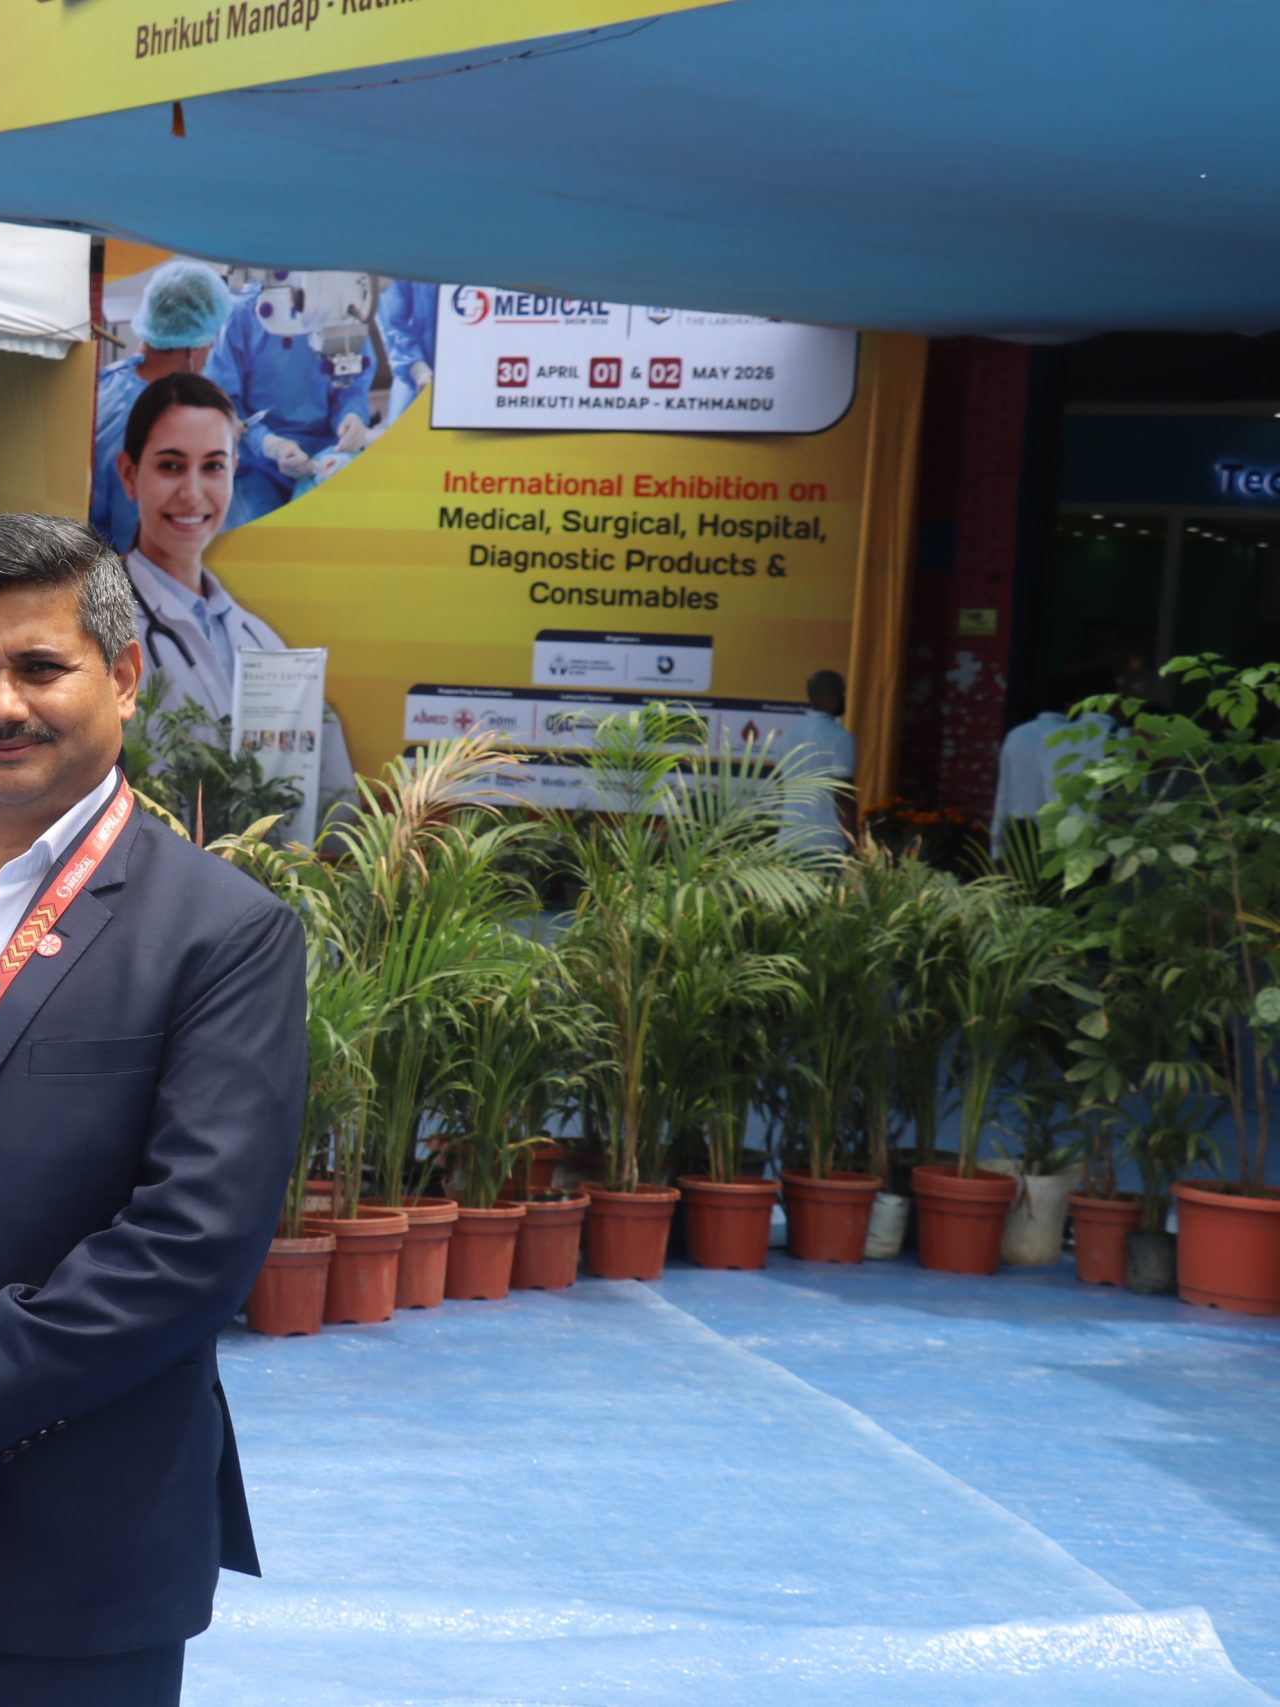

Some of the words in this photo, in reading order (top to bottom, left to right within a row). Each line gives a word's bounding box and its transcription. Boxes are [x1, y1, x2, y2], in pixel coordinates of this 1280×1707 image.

[135, 14, 220, 60] Bhrikuti
[227, 0, 320, 32] Mandap
[494, 295, 610, 316] MEDICAL
[498, 362, 528, 383] 30
[536, 366, 579, 379] APRIL
[593, 362, 619, 384] 01
[630, 366, 641, 379] &
[650, 363, 680, 384] 02
[692, 366, 730, 380] MAY
[734, 366, 775, 380] 2026
[496, 396, 574, 409] BHRIKUTI
[579, 396, 650, 409] MANDAP
[665, 397, 775, 411] KATHMANDU
[443, 470, 623, 497] International
[634, 474, 779, 501] Exhibition
[789, 482, 827, 502] on
[438, 506, 551, 535] Medical,
[562, 509, 688, 540] Surgical,
[698, 514, 827, 544] Hospital,
[469, 545, 615, 573] Diagnostic
[625, 550, 756, 577] Products
[767, 554, 787, 578] &
[529, 582, 719, 610] Consumables
[97, 814, 119, 843] NEPAL
[67, 856, 94, 889] MEDICAL
